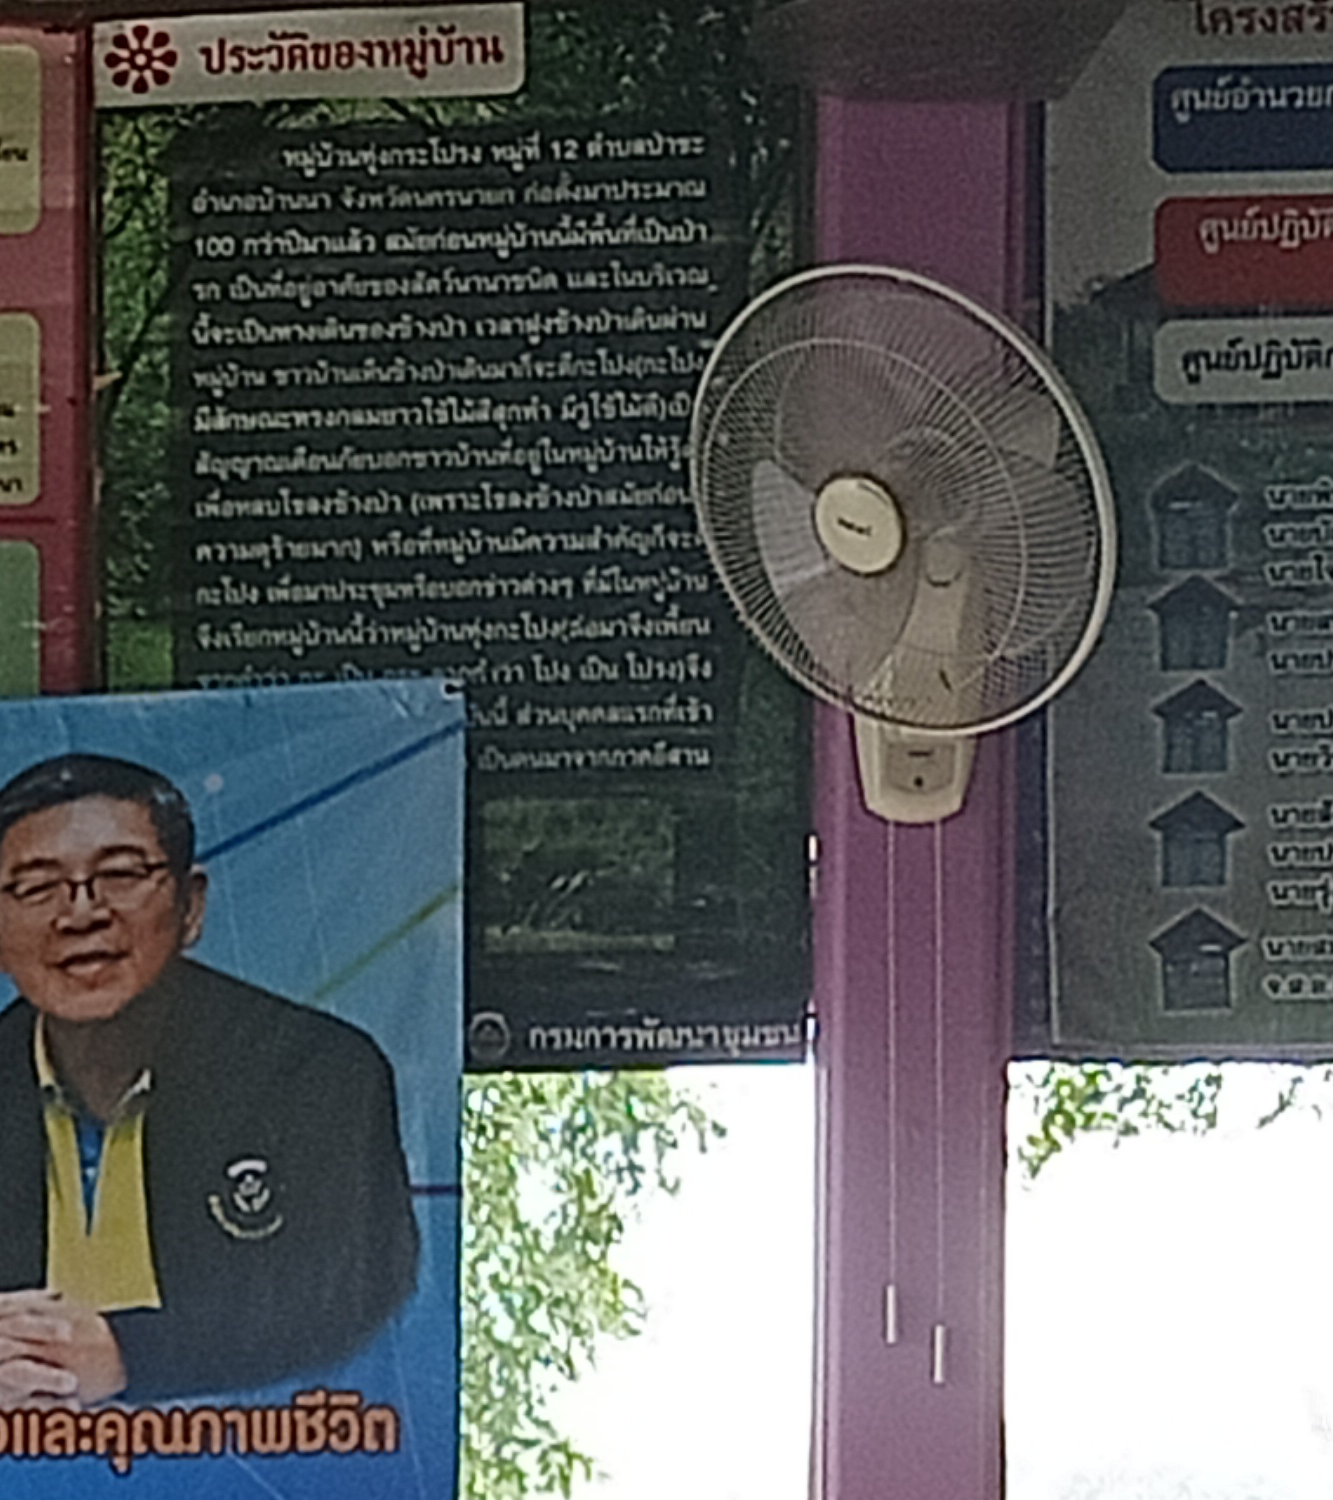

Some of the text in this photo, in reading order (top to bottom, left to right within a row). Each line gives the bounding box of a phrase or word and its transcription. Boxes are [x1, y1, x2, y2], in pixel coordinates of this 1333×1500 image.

[1196, 0, 1333, 36] โครงสร
[200, 23, 504, 80] ประวัติของหมู่บ้าน
[550, 141, 578, 161] 12
[191, 184, 332, 214] อำเภอบ้านนา
[342, 181, 515, 210] จังหวัดนครนายก
[194, 237, 234, 257] 100
[529, 1017, 801, 1058] กรมการพัฒนาชุมชน
